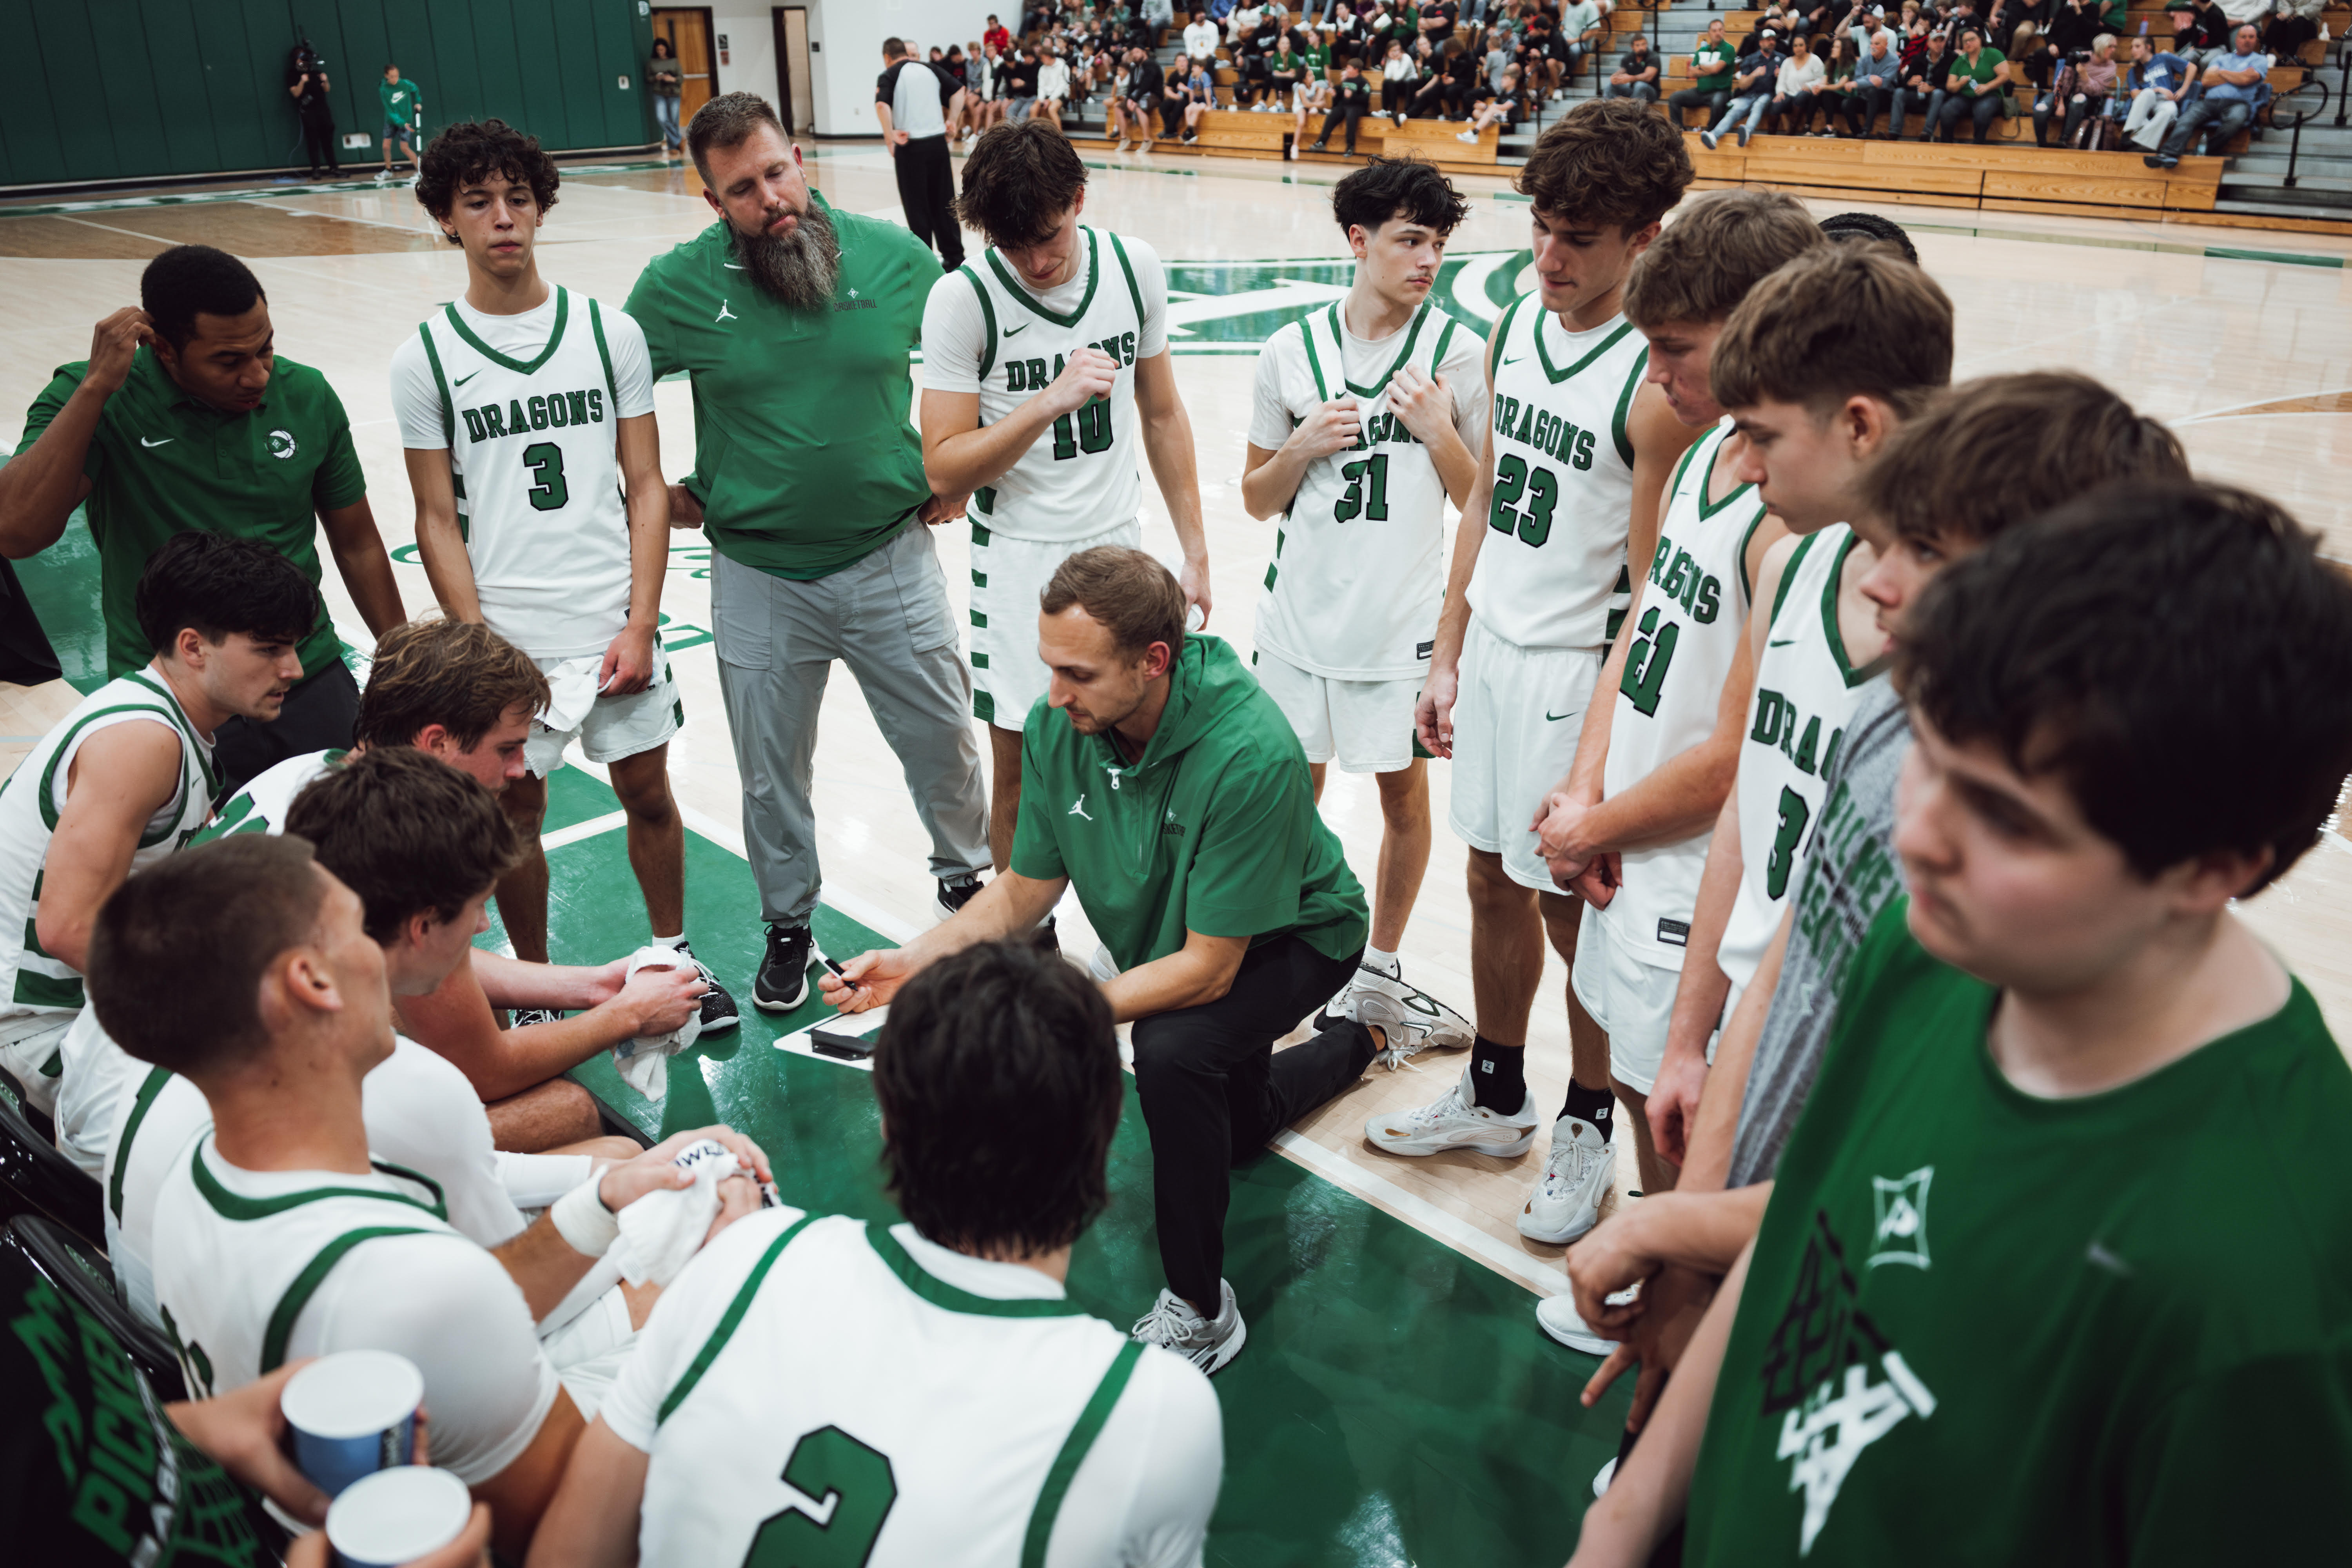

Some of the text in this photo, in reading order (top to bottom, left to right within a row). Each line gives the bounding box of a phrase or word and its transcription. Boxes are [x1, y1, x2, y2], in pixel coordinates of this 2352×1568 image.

[833, 299, 877, 312] BASKETBALL
[1005, 331, 1135, 392] DRANS
[462, 389, 603, 443] DRAGONS
[1053, 393, 1114, 461] 10
[1339, 412, 1424, 451] AGON
[1495, 393, 1595, 471] DRAGONS
[523, 442, 568, 511] 3
[1334, 454, 1388, 523] 31
[1490, 453, 1558, 548] 23
[1767, 784, 1823, 901] 3
[1164, 1305, 1182, 1317] NIKE
[742, 1424, 898, 1568] 2
